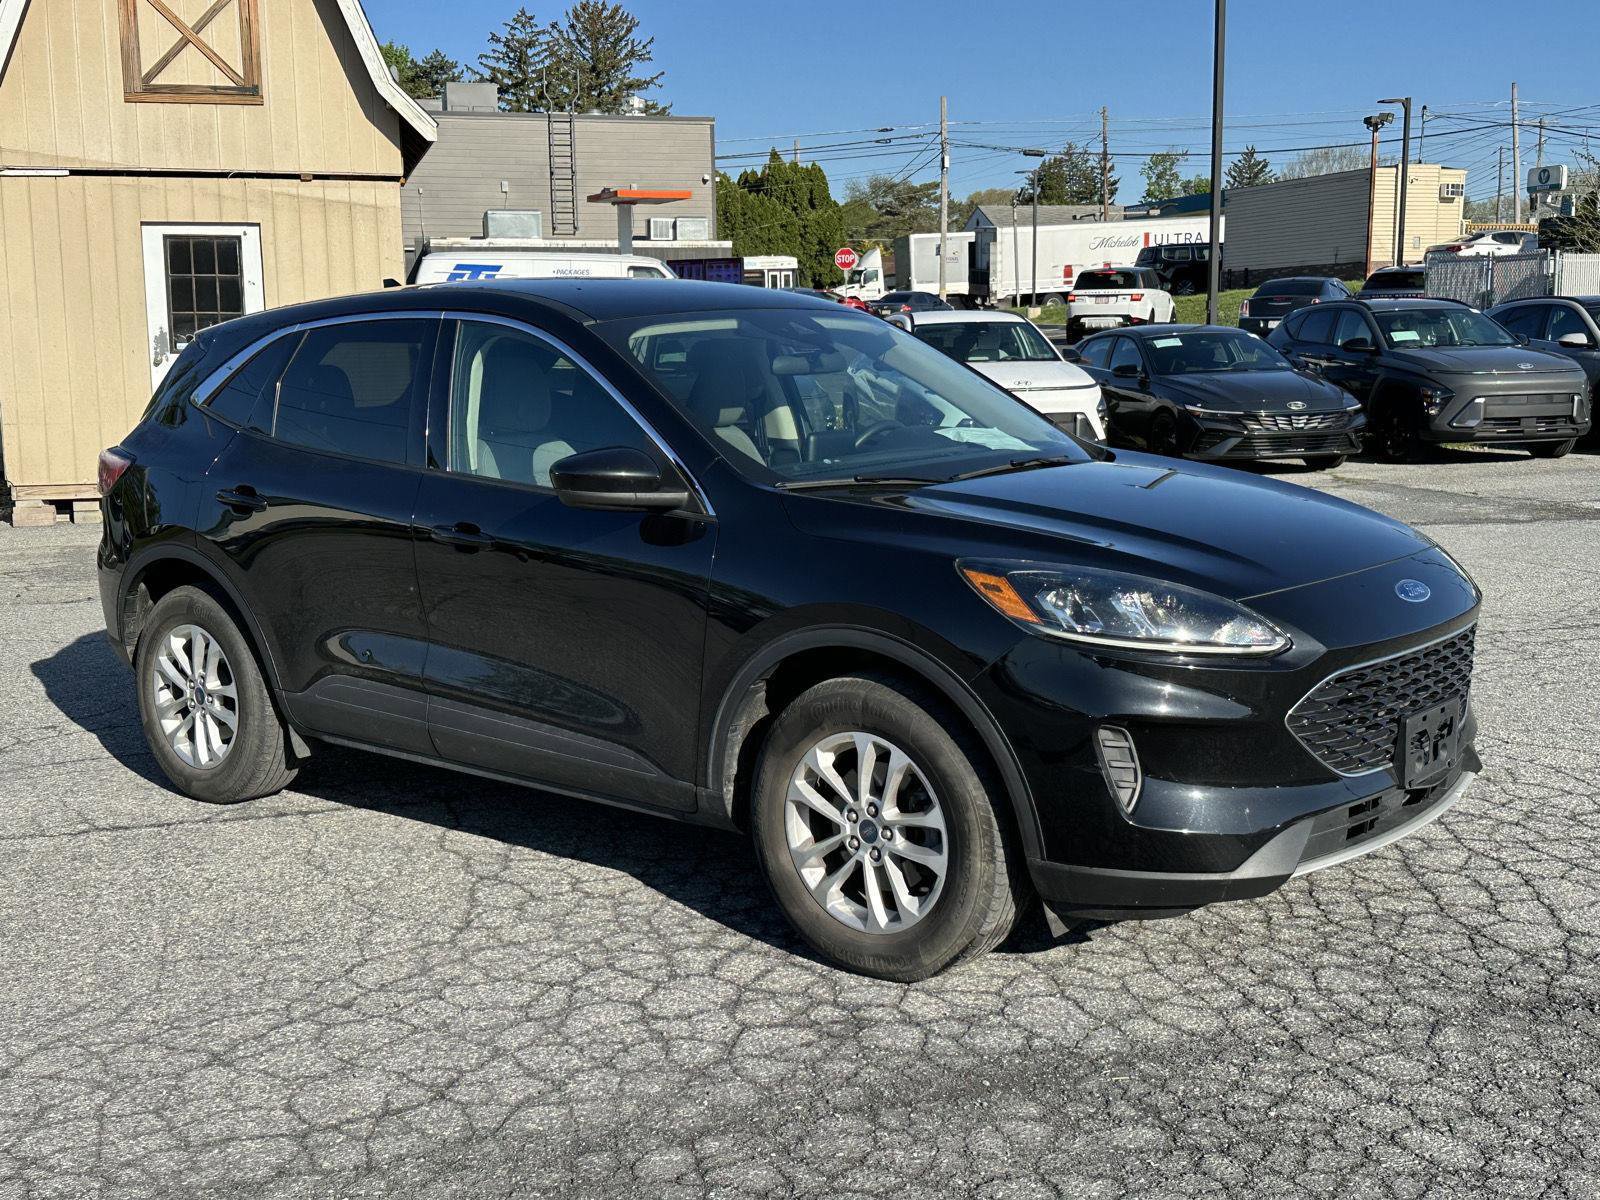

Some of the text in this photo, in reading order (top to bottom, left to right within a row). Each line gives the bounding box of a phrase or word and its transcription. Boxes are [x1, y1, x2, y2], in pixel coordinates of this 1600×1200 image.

[1089, 232, 1203, 251] Michelob ULTRA
[836, 254, 855, 264] STOP
[556, 268, 590, 276] PACKAGES
